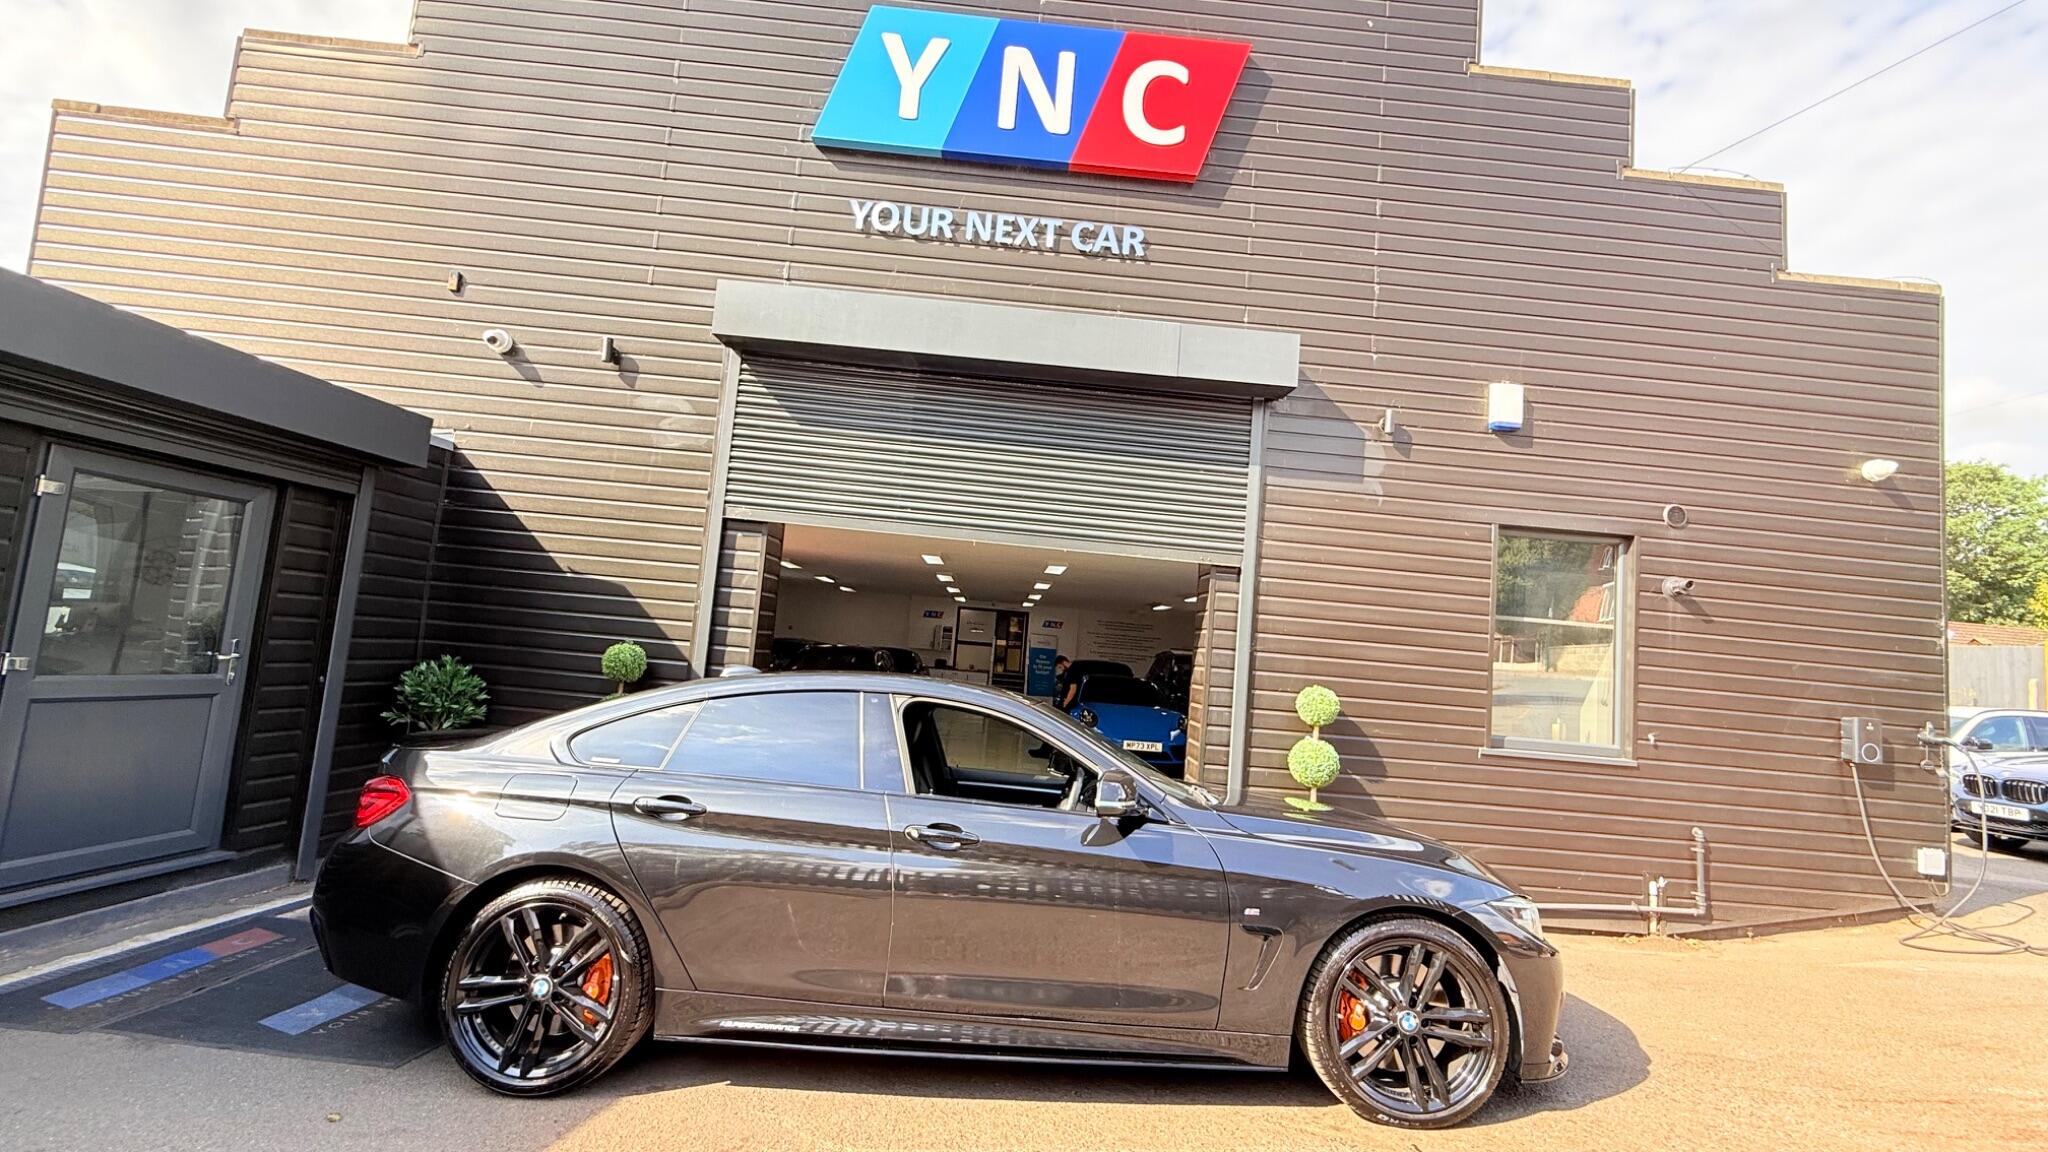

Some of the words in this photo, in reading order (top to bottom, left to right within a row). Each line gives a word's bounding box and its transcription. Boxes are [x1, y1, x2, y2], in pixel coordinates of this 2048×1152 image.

[881, 32, 1190, 146] YNC
[850, 200, 953, 239] YOUR
[965, 211, 1063, 248] NEXT
[1071, 221, 1146, 257] CAR
[1146, 743, 1160, 751] XPL
[312, 1010, 373, 1034] YOUR
